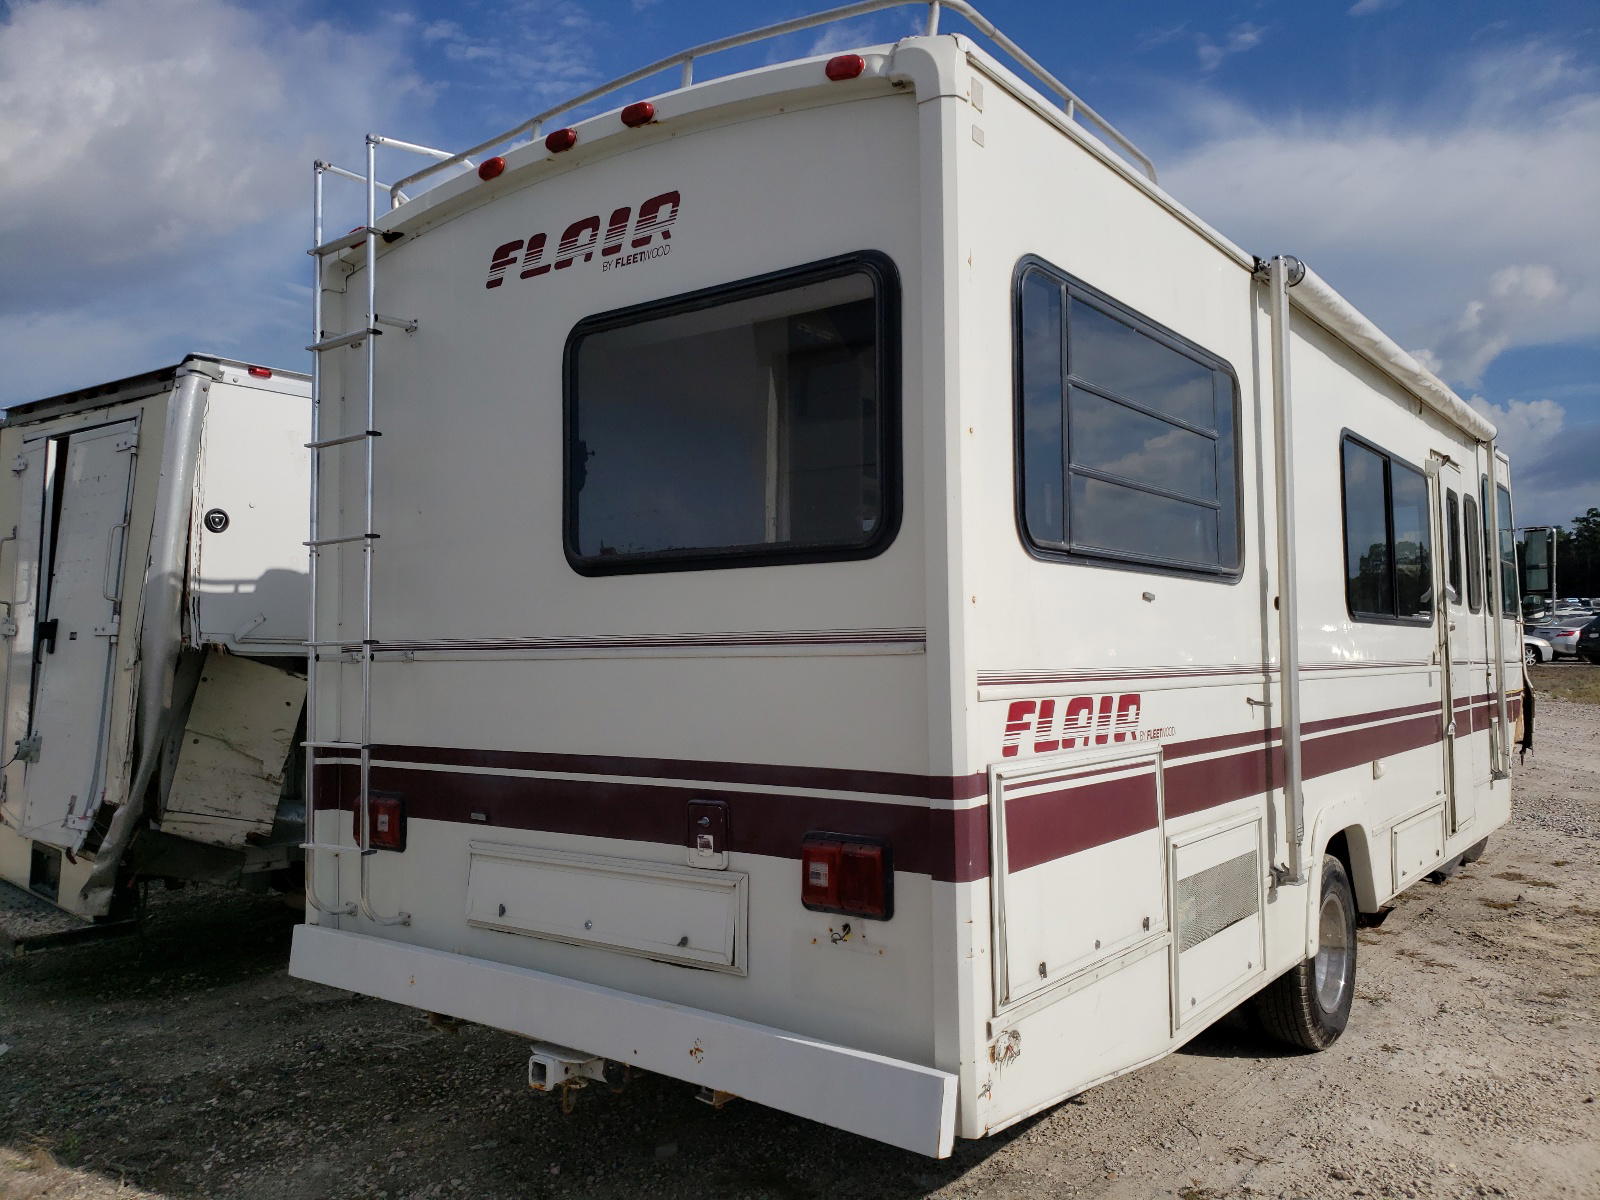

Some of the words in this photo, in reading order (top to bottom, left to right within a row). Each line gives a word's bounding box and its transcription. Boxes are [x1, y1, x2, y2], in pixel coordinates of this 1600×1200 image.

[486, 190, 681, 289] FLAIR
[602, 259, 613, 272] BY
[614, 244, 671, 269] FLEETWOOD
[1002, 693, 1141, 758] FLAIR
[1139, 730, 1147, 742] BY
